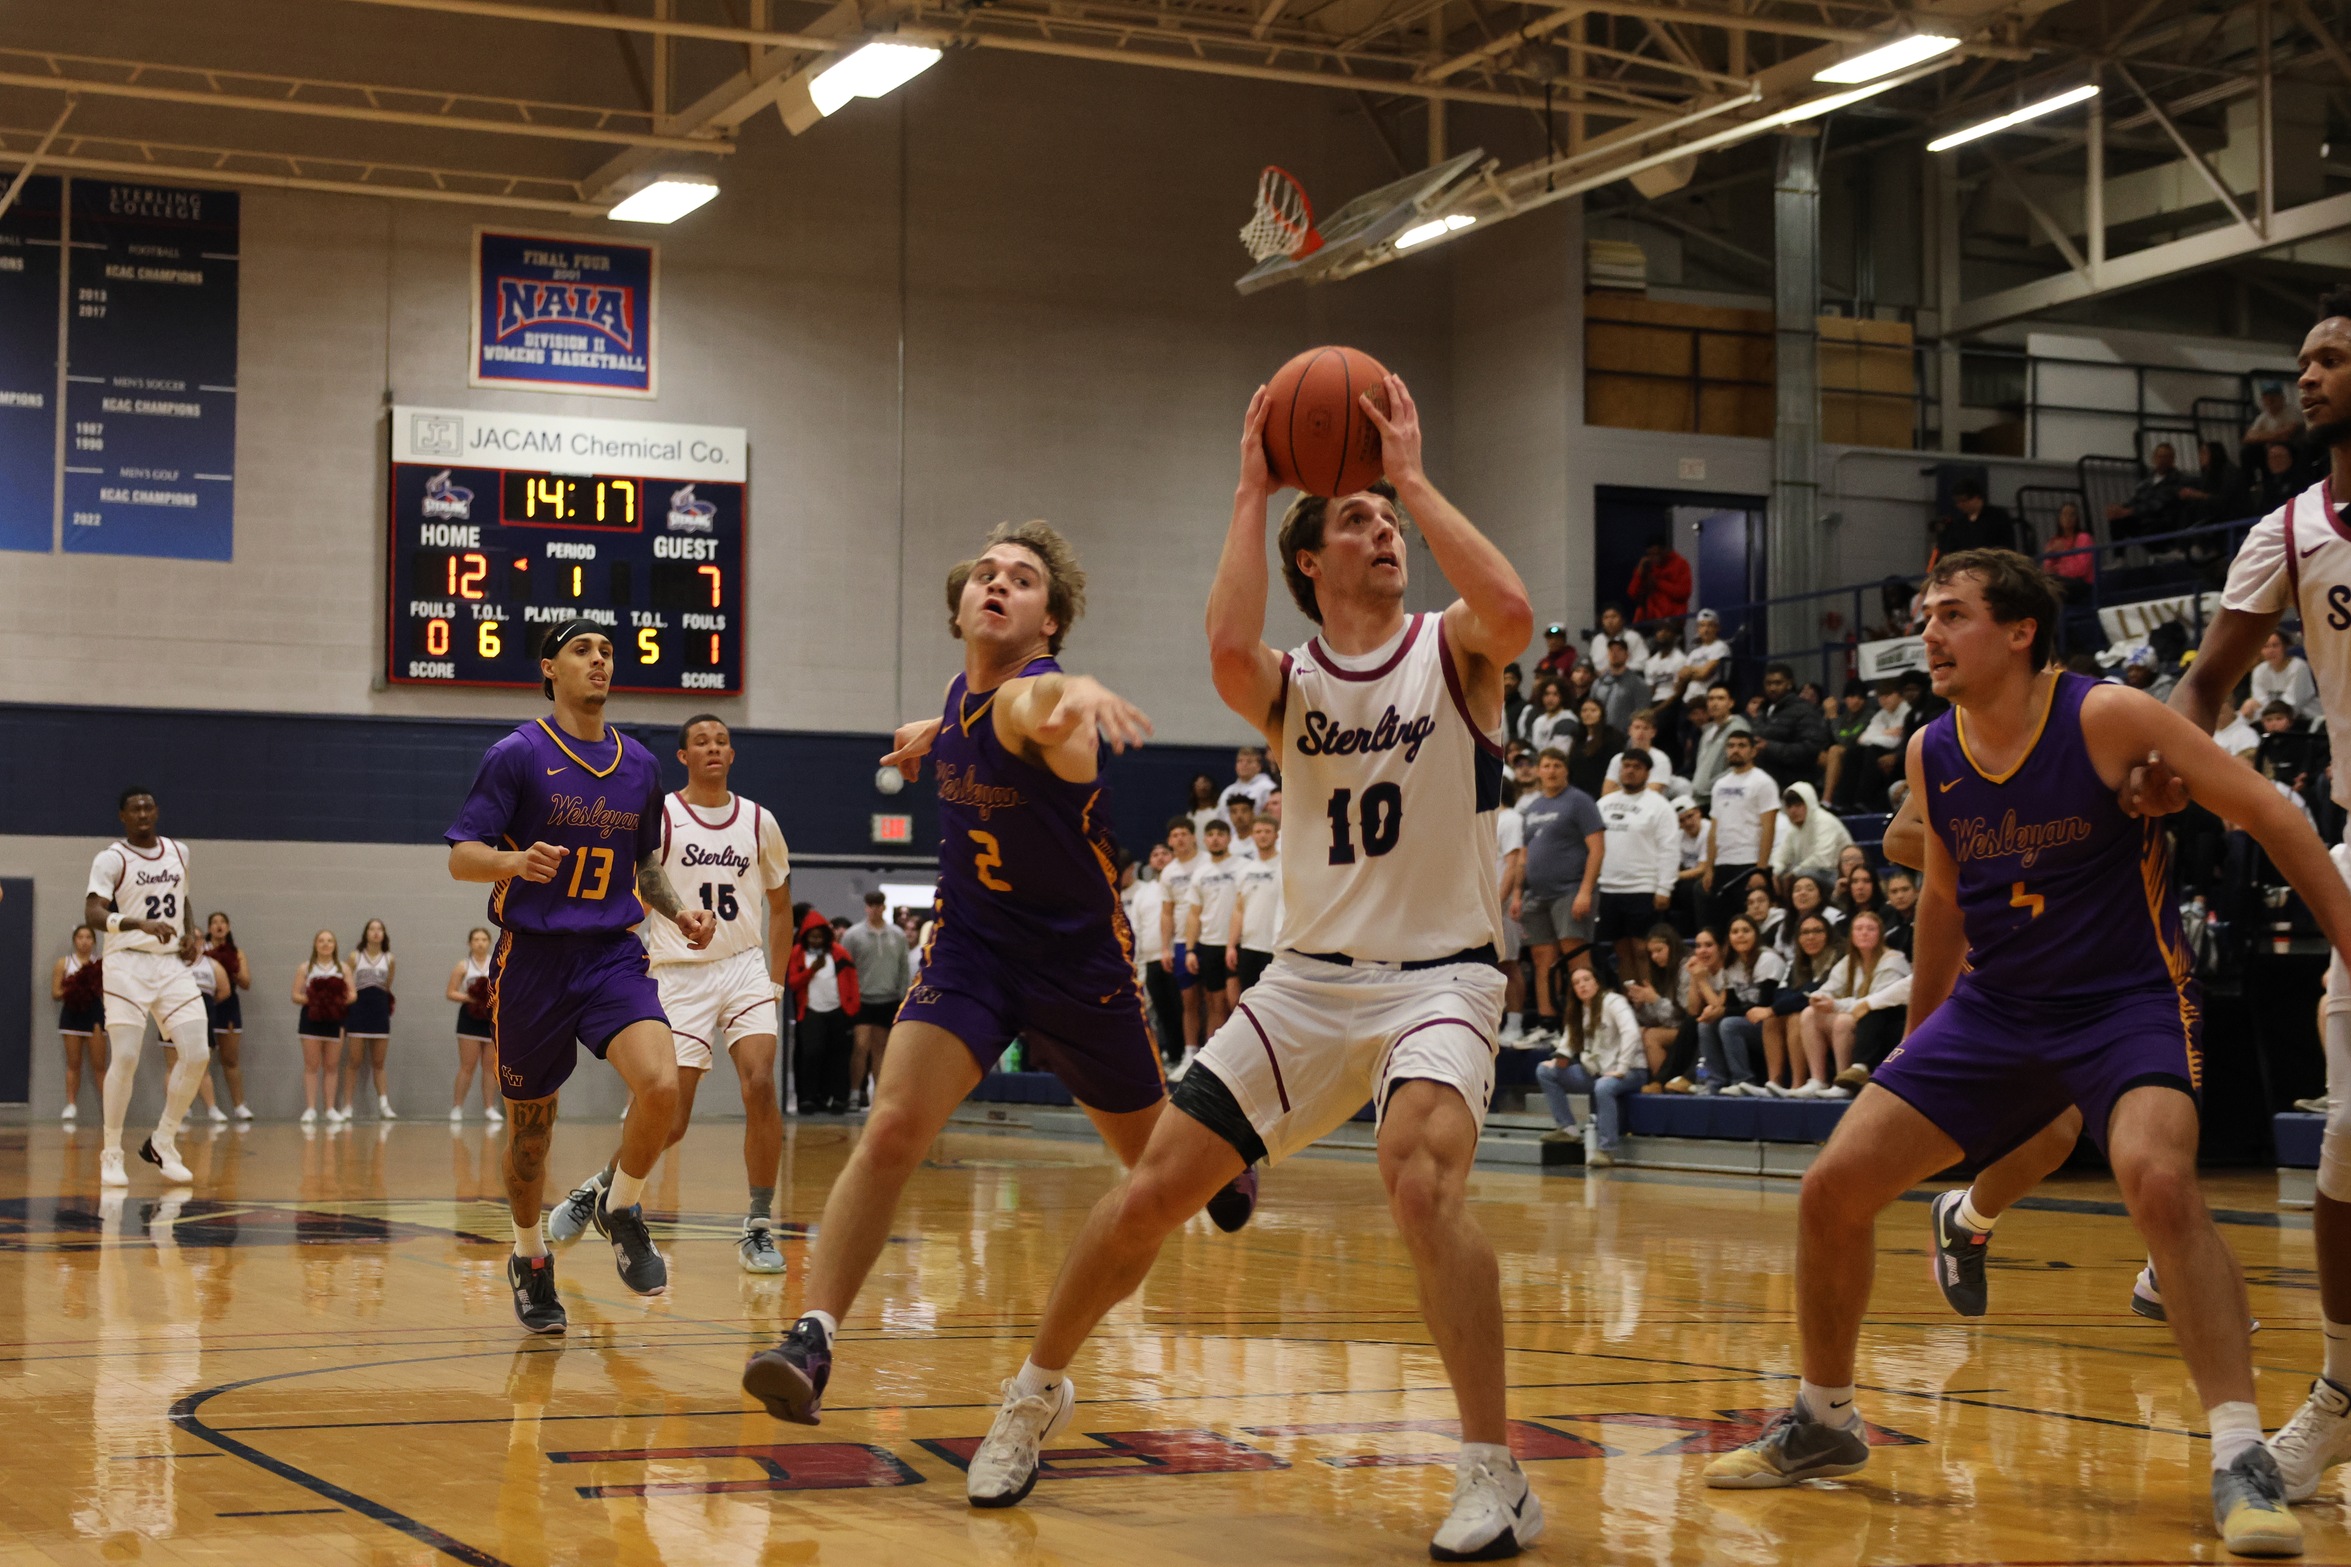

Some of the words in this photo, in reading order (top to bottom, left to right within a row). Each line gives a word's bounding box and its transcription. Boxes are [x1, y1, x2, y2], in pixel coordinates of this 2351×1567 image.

[109, 200, 201, 220] COLLEGE
[110, 187, 201, 208] STERLING
[523, 250, 568, 269] FINAL
[573, 254, 611, 271] FOUR
[137, 267, 203, 284] CHAMPIONS
[498, 277, 633, 350] NAIA
[524, 331, 588, 350] DIVISION
[593, 336, 606, 353] II
[483, 345, 545, 365] WOMENS
[551, 350, 646, 373] BASKETBALL
[145, 378, 186, 392] SOCCER
[102, 396, 133, 412] KCAC
[134, 399, 201, 418] CHAMPIONS
[470, 428, 562, 453] JACAM
[571, 433, 682, 461] Chemical
[691, 440, 730, 464] Co.
[152, 469, 180, 482] GOLF
[100, 487, 130, 503] KCAC
[131, 489, 198, 508] CHAMPIONS
[526, 478, 635, 523] 14:17
[421, 523, 481, 548] HOME
[654, 535, 719, 561] GUEST
[546, 542, 597, 561] PERIOD
[448, 553, 488, 600] 12
[572, 565, 583, 598] 1
[698, 565, 722, 609] 7
[410, 601, 456, 619] FOULS
[471, 604, 510, 621] T.O.L.
[630, 611, 668, 628] T.O.L.
[682, 612, 727, 631] FOULS
[427, 618, 449, 656] 0
[479, 621, 501, 658] 6
[637, 628, 660, 664] 5
[710, 633, 720, 665] 1
[409, 661, 455, 679] SCORE
[681, 672, 726, 689] SCORE
[1297, 704, 1436, 763] Sterling
[547, 793, 641, 839] Wesleyan
[1327, 781, 1403, 866] 10
[1950, 808, 2092, 869] Wesleyan
[567, 847, 614, 900] 13
[681, 844, 751, 877] Sterling
[968, 829, 1013, 891] 2
[136, 869, 182, 888] Sterling
[145, 893, 177, 920] 23
[699, 882, 740, 921] 15
